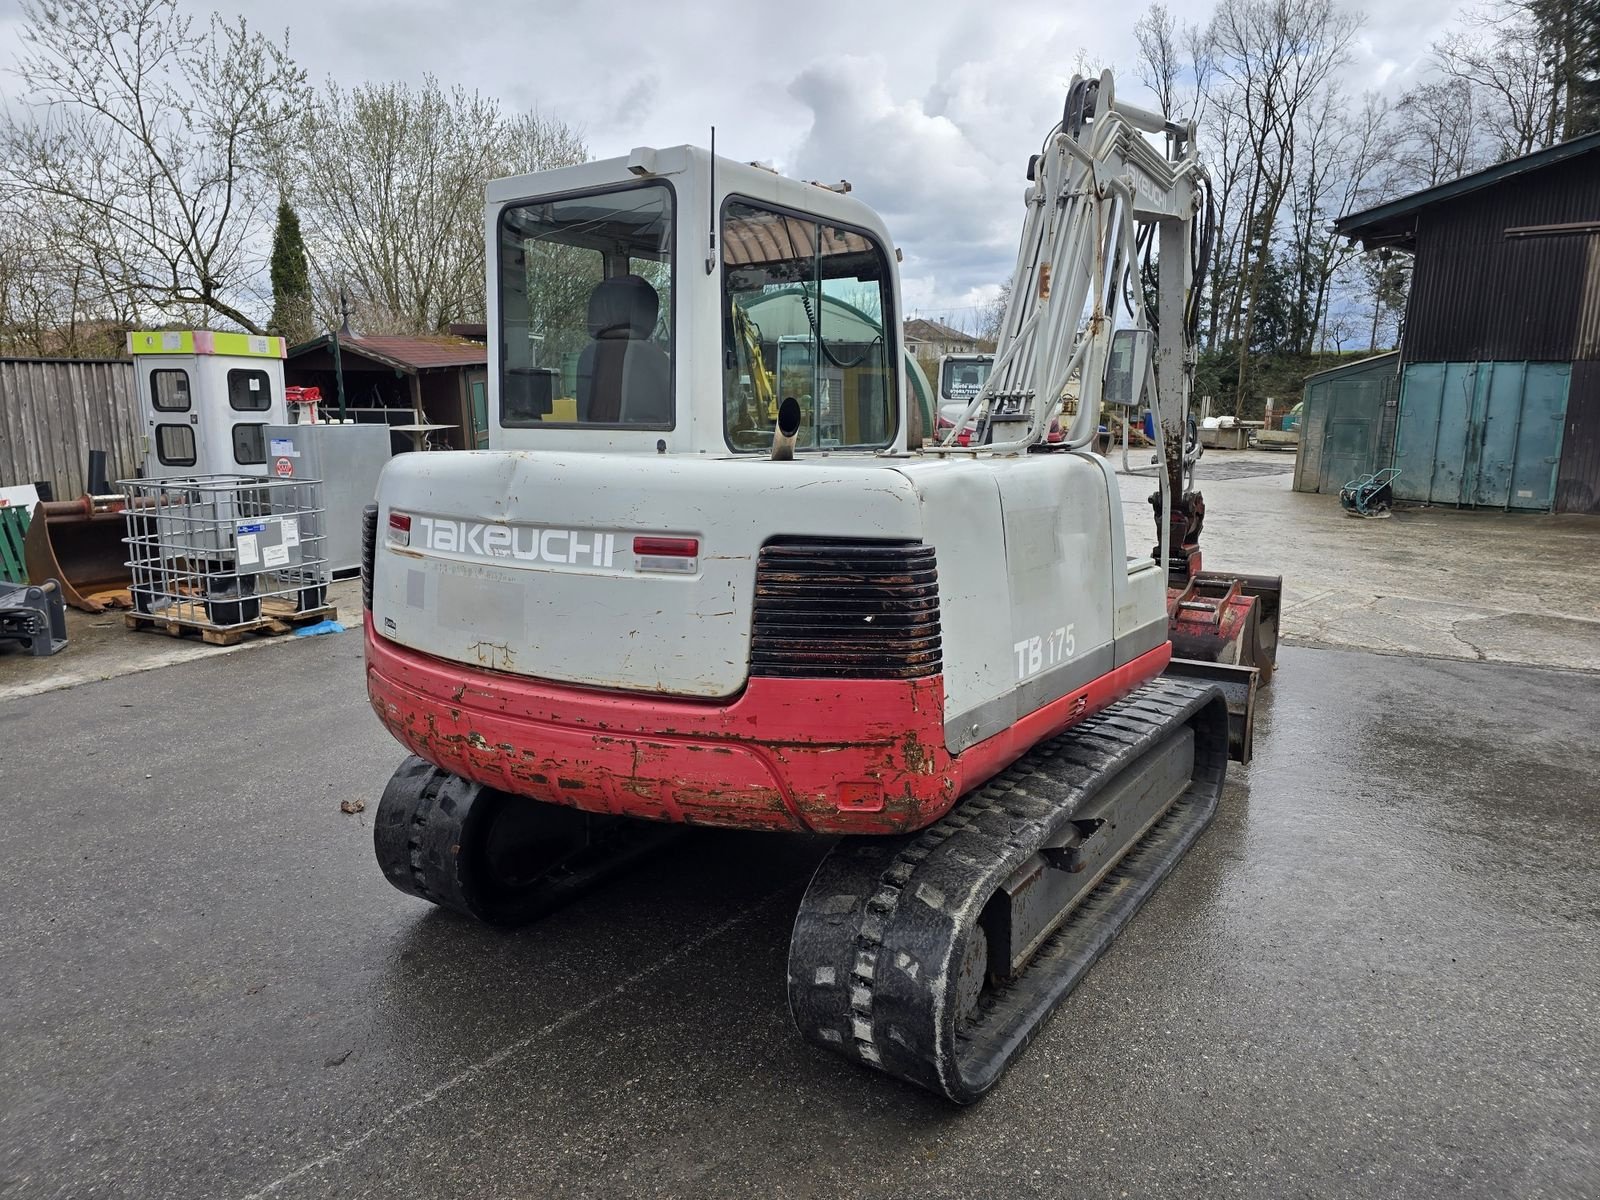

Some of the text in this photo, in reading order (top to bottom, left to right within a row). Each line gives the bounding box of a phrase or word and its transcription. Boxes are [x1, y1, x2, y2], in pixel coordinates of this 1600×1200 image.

[420, 517, 616, 568] TAKEUCHI
[1013, 622, 1075, 679] TB 175
